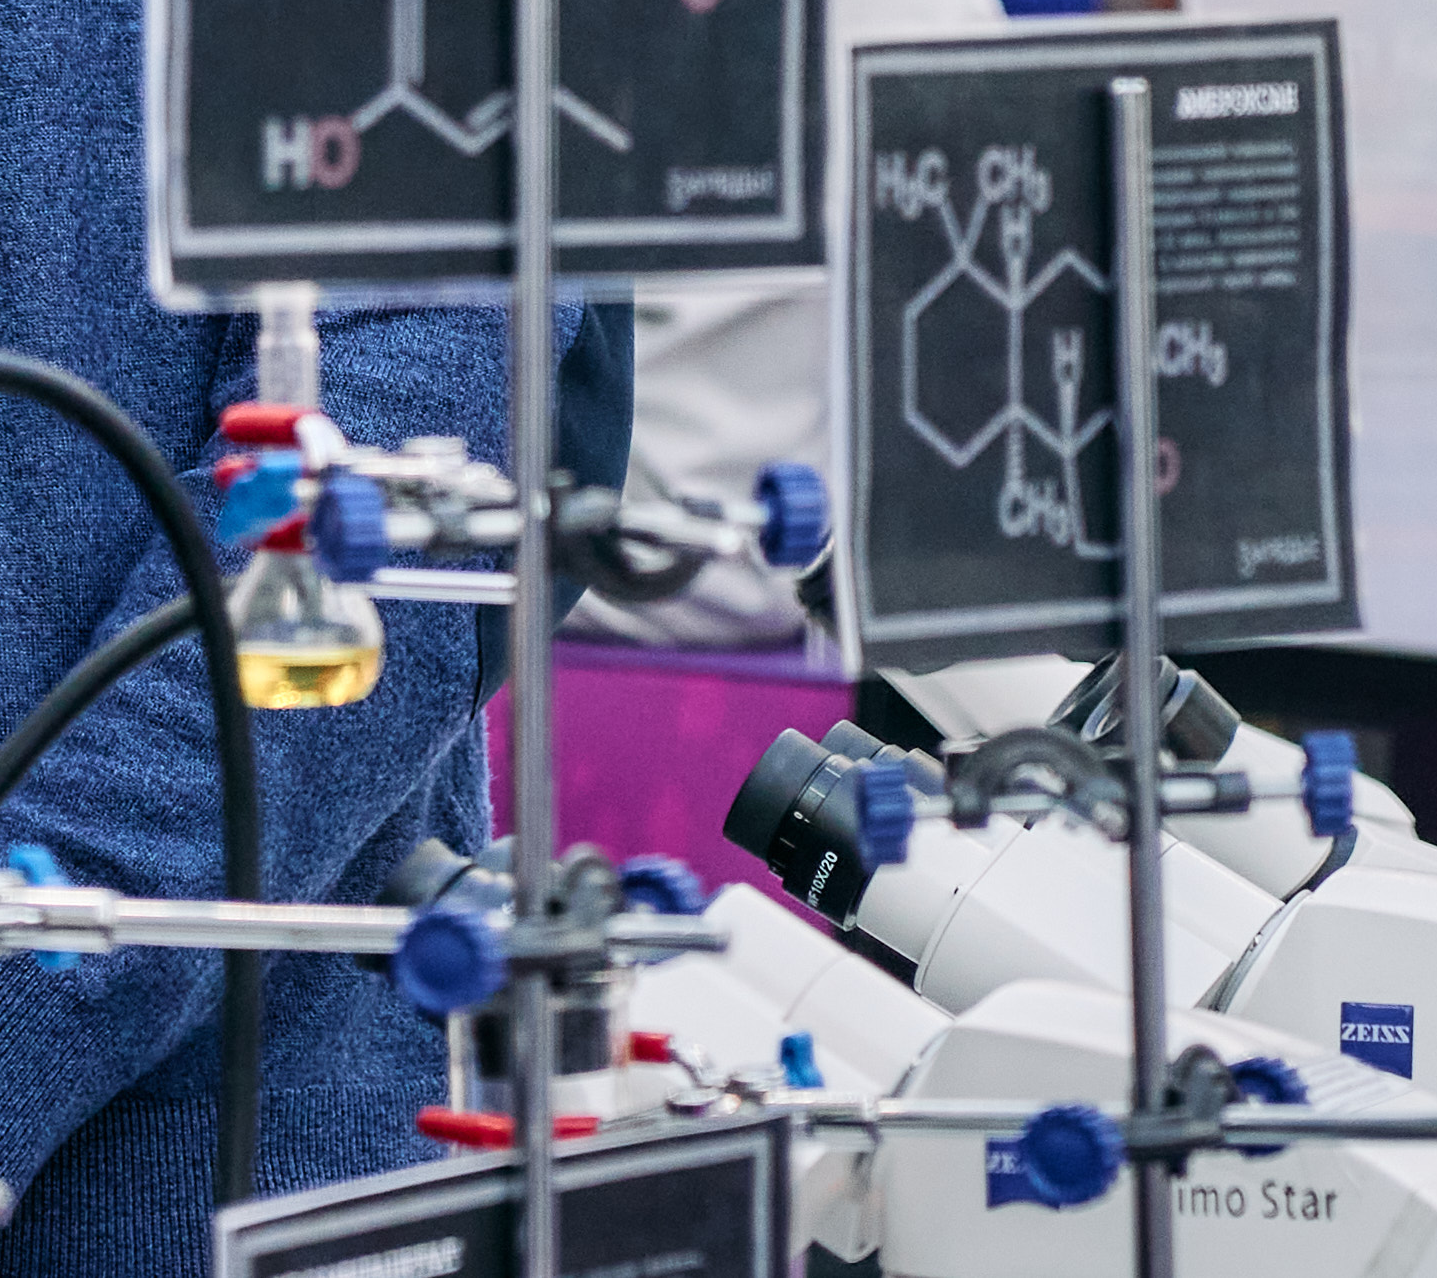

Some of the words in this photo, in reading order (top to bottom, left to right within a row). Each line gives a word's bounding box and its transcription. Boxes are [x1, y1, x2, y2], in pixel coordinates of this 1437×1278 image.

[1341, 1022, 1410, 1044] ZEISS
[1178, 1181, 1247, 1219] imo
[1260, 1181, 1337, 1221] Star
